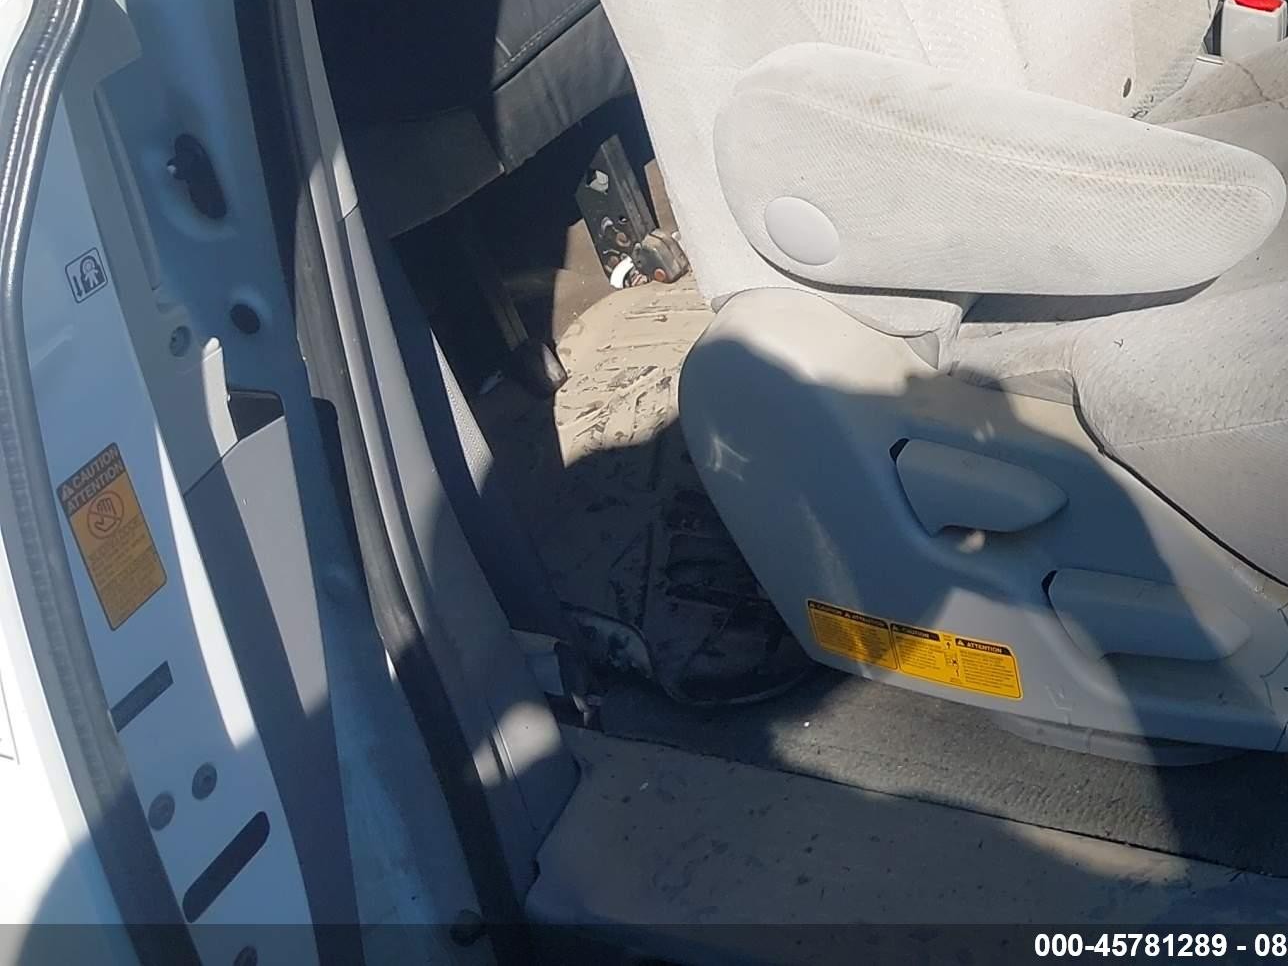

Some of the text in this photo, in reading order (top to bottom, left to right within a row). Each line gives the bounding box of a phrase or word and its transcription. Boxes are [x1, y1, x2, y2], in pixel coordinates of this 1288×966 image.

[66, 462, 125, 512] ATTENTION
[72, 446, 119, 489] CAUTION
[966, 640, 1003, 654] ATTENTION
